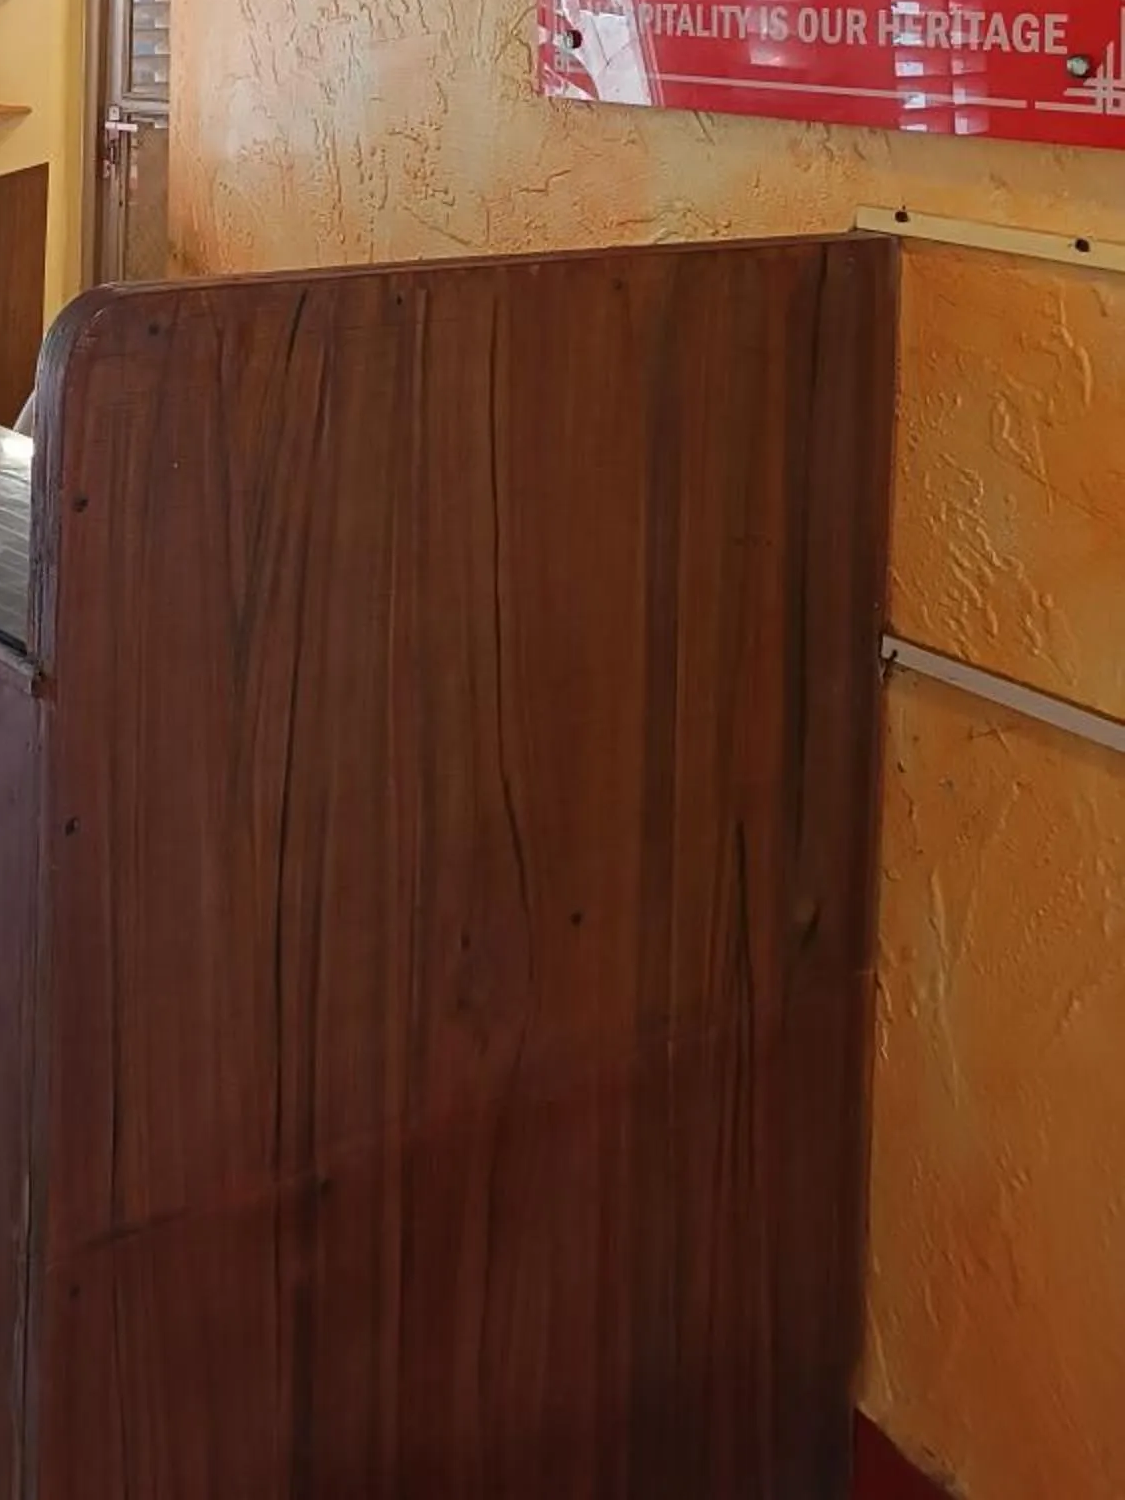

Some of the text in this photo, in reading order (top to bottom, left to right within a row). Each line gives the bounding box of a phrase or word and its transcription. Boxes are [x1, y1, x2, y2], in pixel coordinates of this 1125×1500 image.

[759, 6, 789, 42] IS
[798, 7, 868, 46] OUR
[879, 9, 1069, 55] HERITAGE
